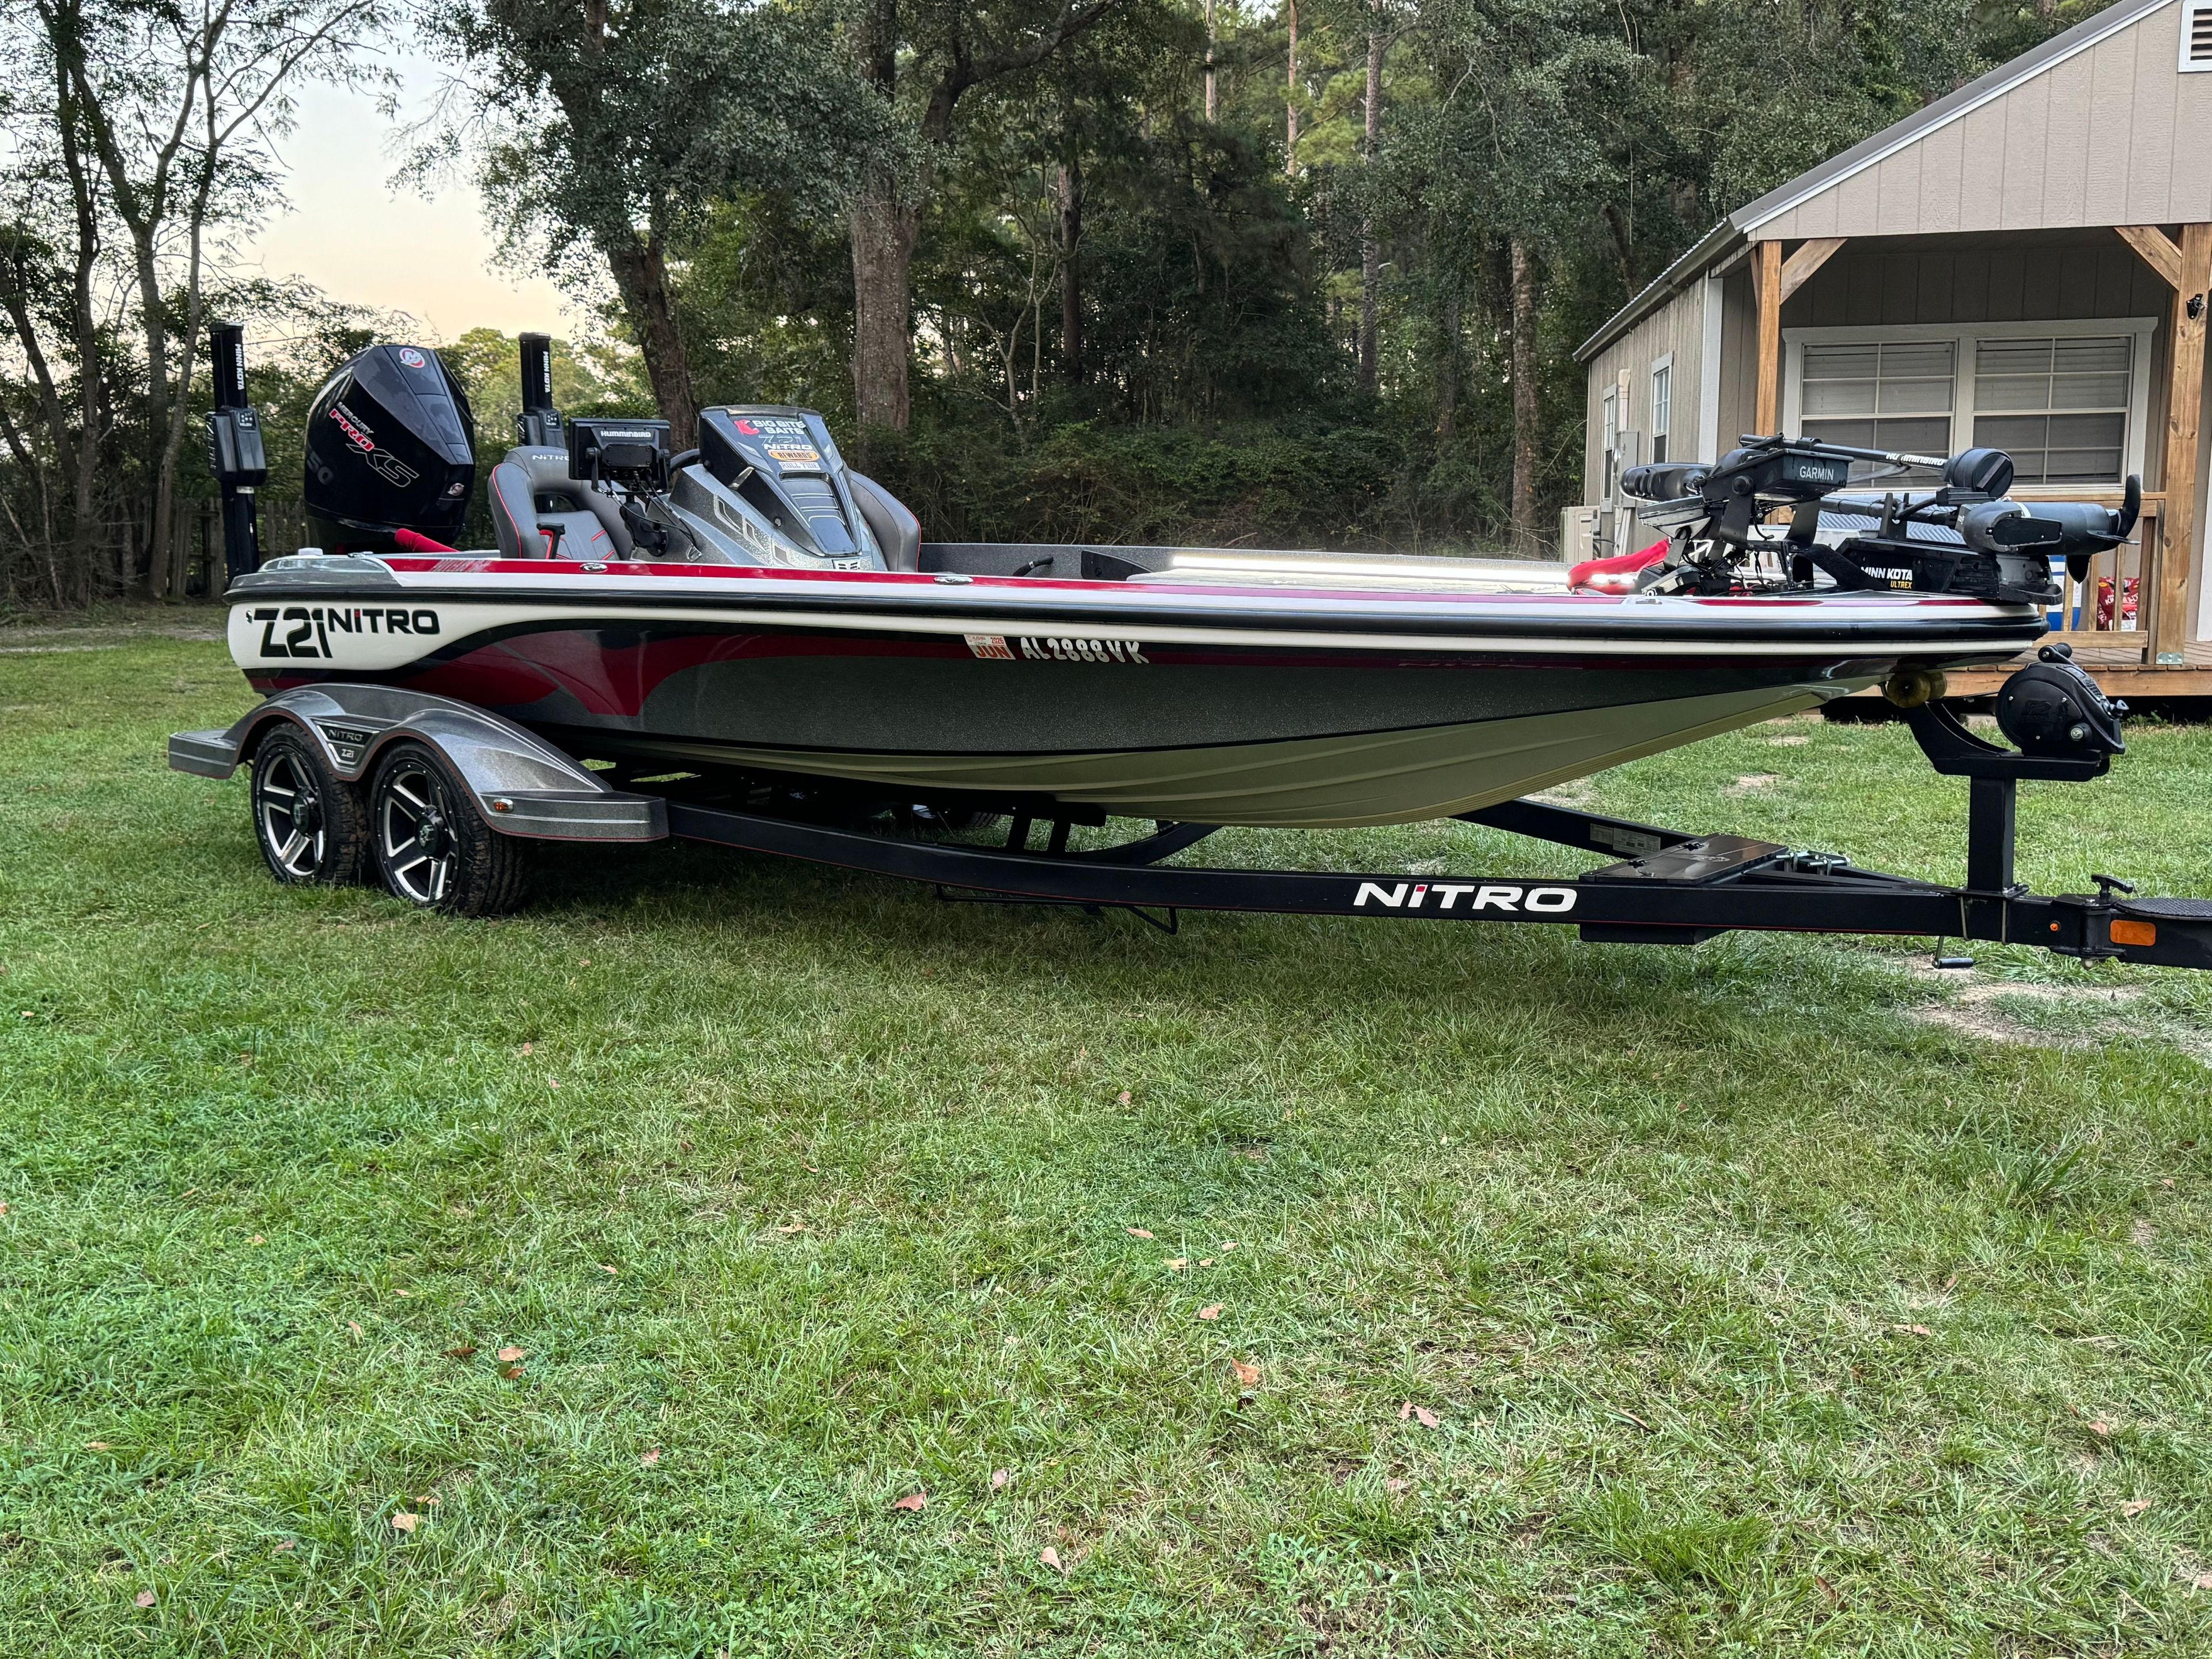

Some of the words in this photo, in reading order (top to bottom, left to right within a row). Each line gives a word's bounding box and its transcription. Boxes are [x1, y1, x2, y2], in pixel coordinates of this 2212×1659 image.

[235, 343, 243, 368] MINN
[236, 368, 245, 390] KOTA
[336, 402, 374, 434] MERCURY
[775, 421, 806, 429] BITE
[329, 408, 374, 452] PRO
[306, 449, 334, 485] 50
[346, 444, 419, 487] XS
[1800, 465, 1834, 480] GARMIN
[1887, 568, 1912, 581] KOTA
[1890, 580, 1912, 589] ULTREX
[254, 607, 333, 658] Z21
[976, 645, 1012, 658] JUN
[1020, 637, 1051, 659] AL
[1047, 638, 1110, 662] 2888
[1106, 640, 1150, 664] VK
[328, 729, 363, 741] NITRO
